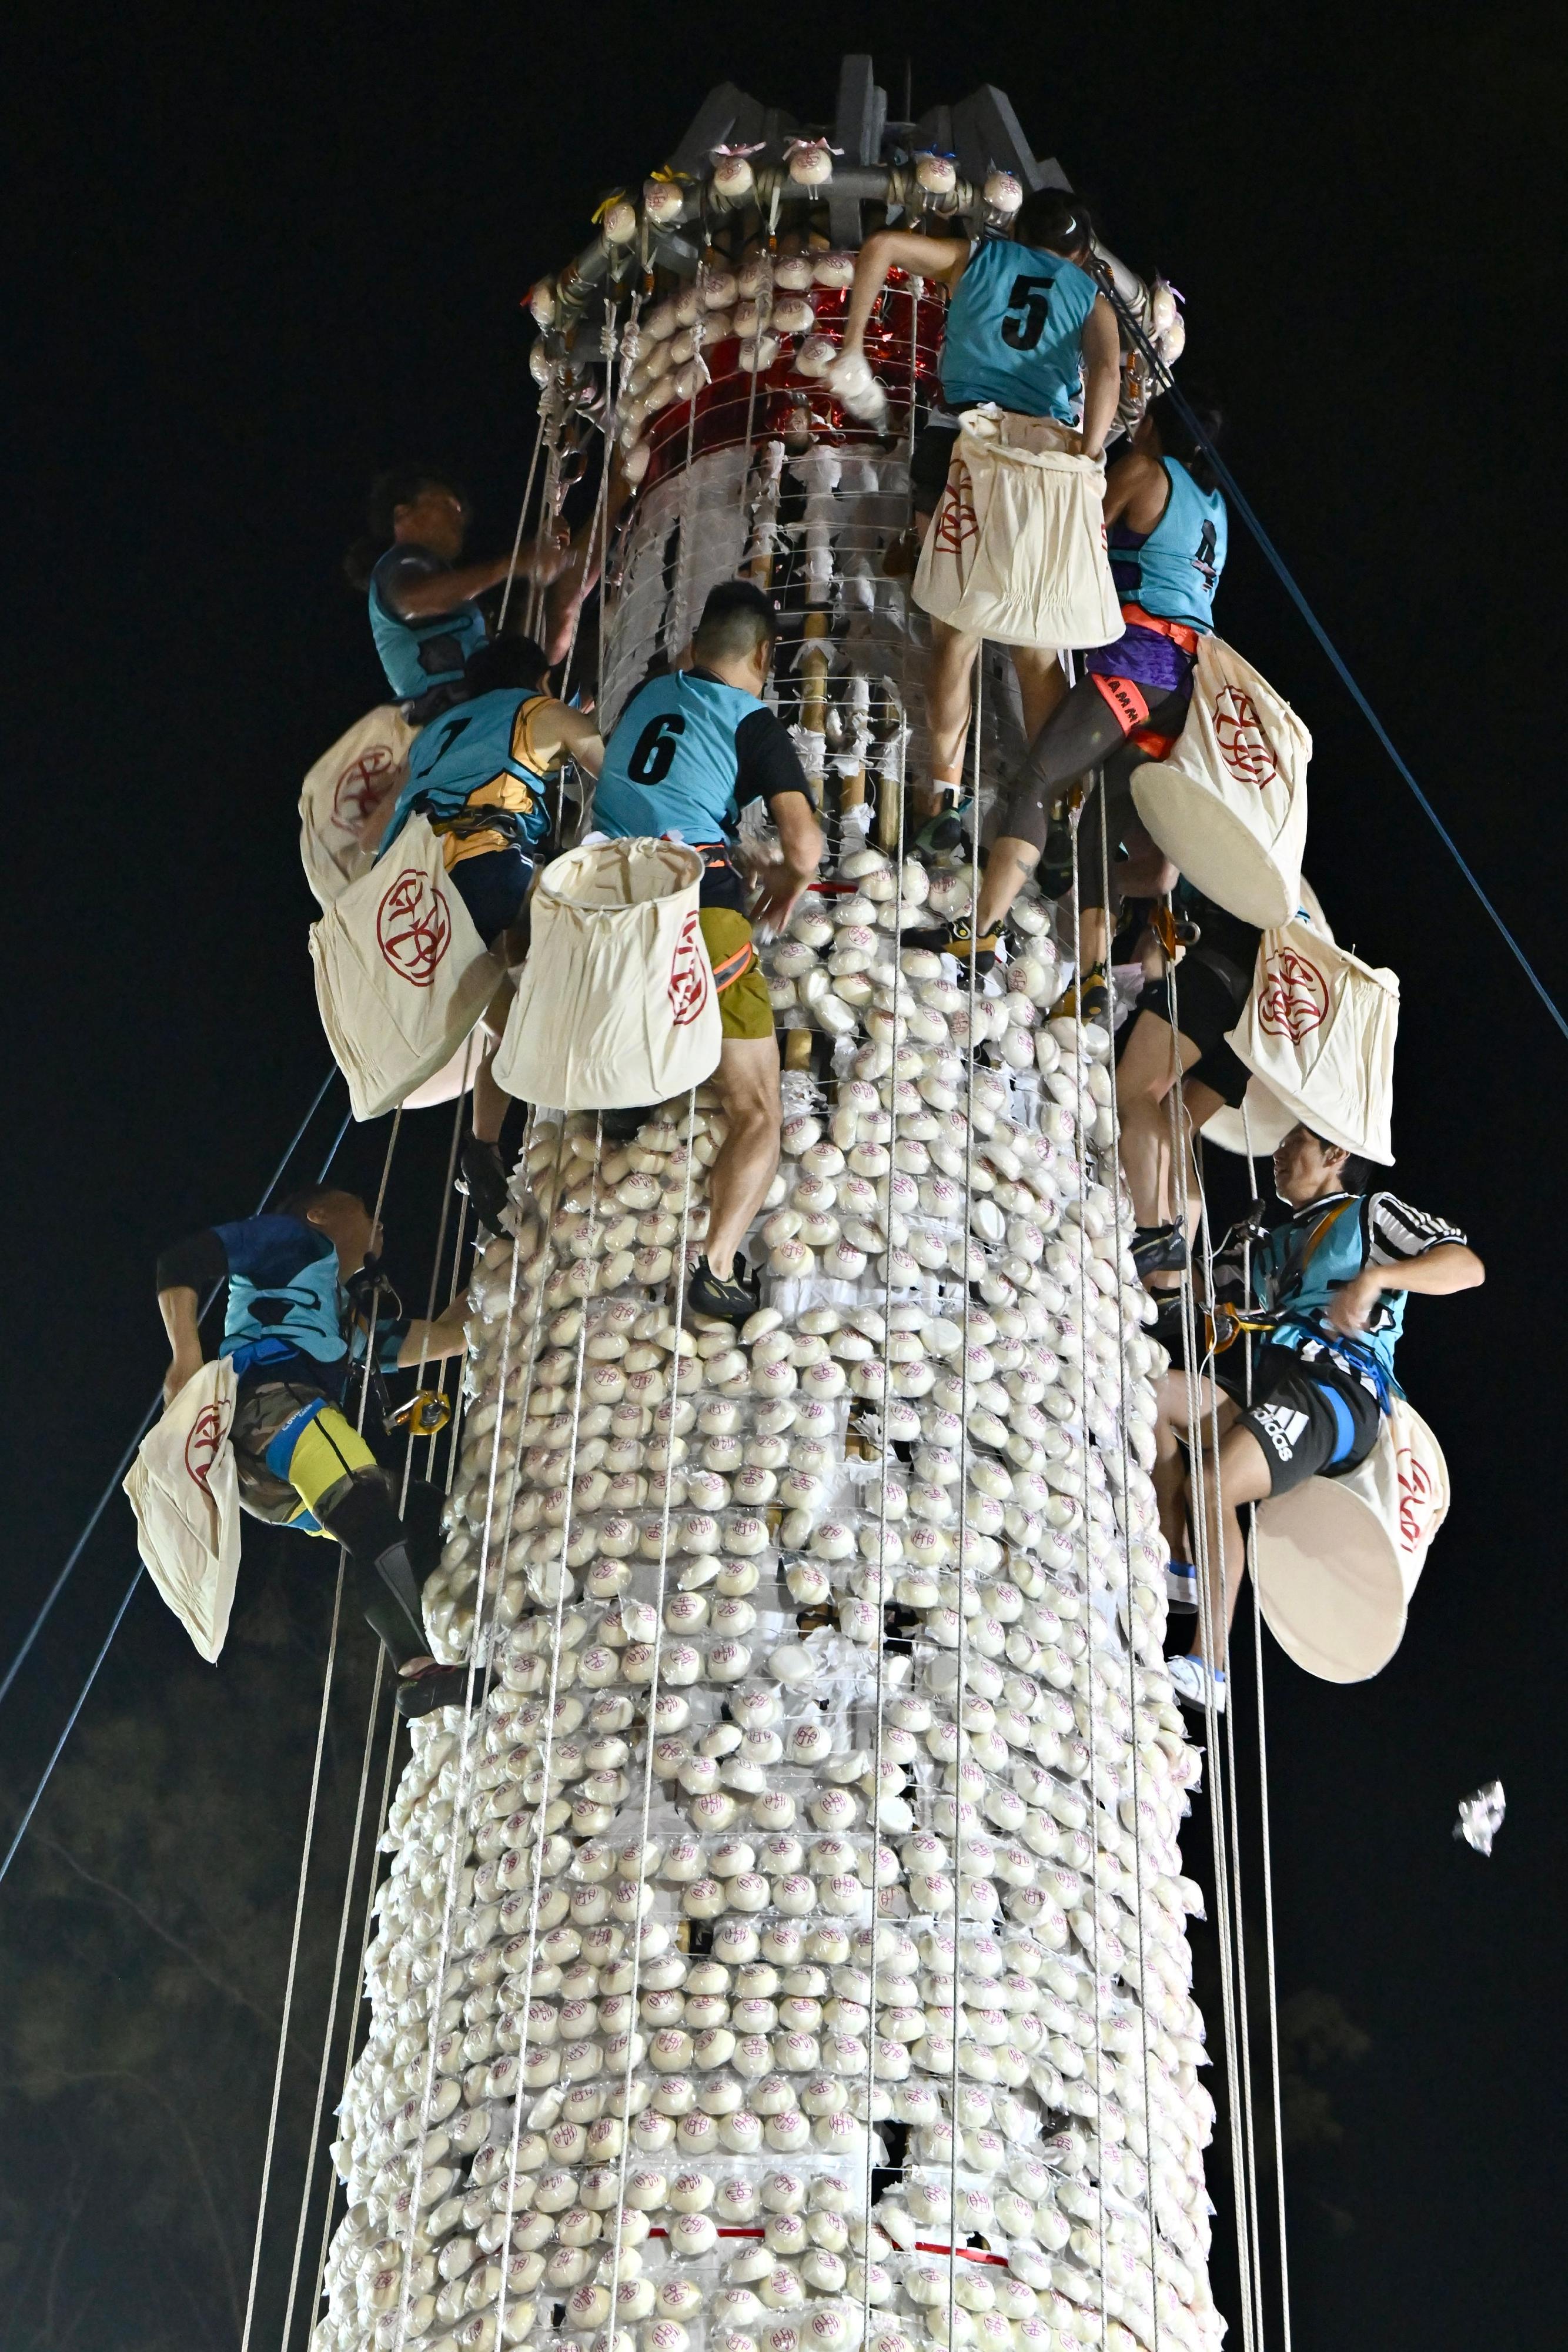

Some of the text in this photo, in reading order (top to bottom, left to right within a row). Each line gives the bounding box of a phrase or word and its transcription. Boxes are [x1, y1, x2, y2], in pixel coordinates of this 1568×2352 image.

[1001, 274, 1054, 351] 5
[1191, 519, 1217, 593] 4
[627, 713, 685, 786] 6
